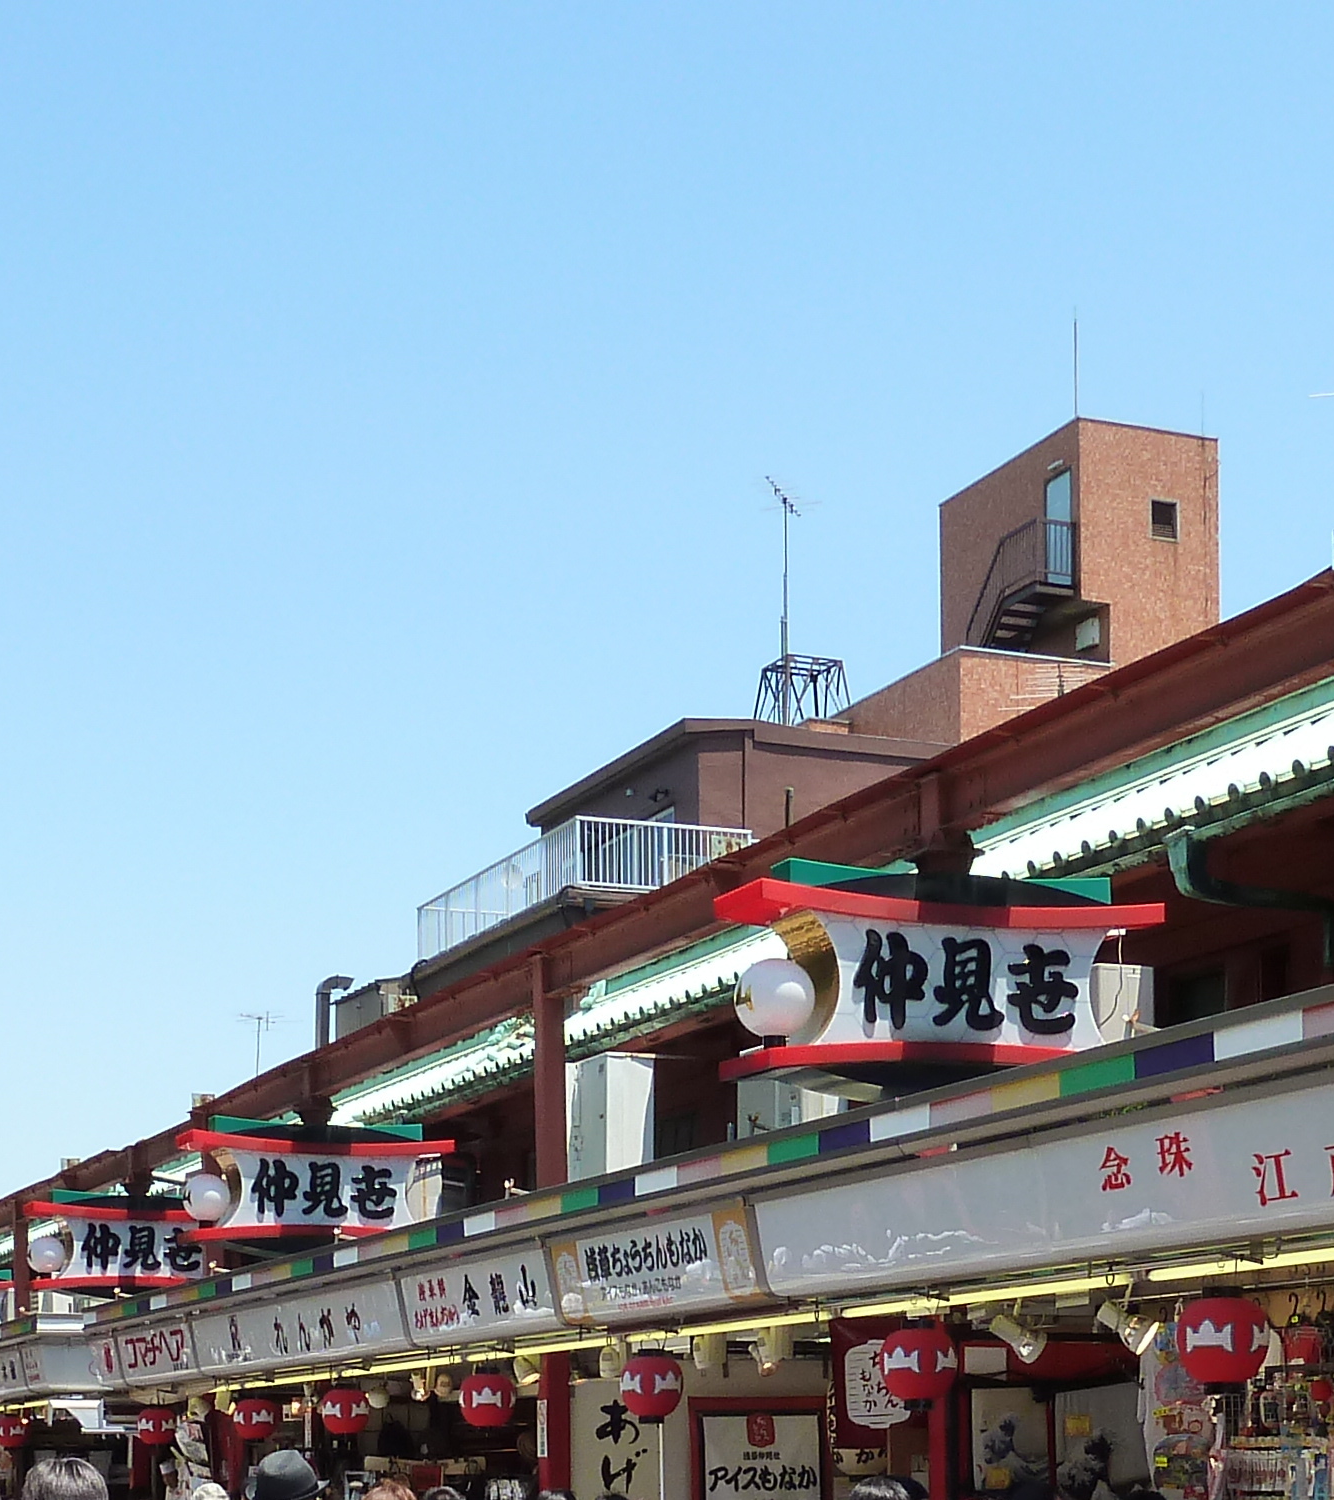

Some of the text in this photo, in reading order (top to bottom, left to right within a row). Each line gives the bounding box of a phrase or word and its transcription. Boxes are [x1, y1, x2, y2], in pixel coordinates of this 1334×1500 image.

[854, 929, 1079, 1035] 仲見世
[252, 1158, 398, 1220] 仲見世
[1098, 1131, 1194, 1192] 念珠
[708, 1463, 818, 1493] アイスもなか
